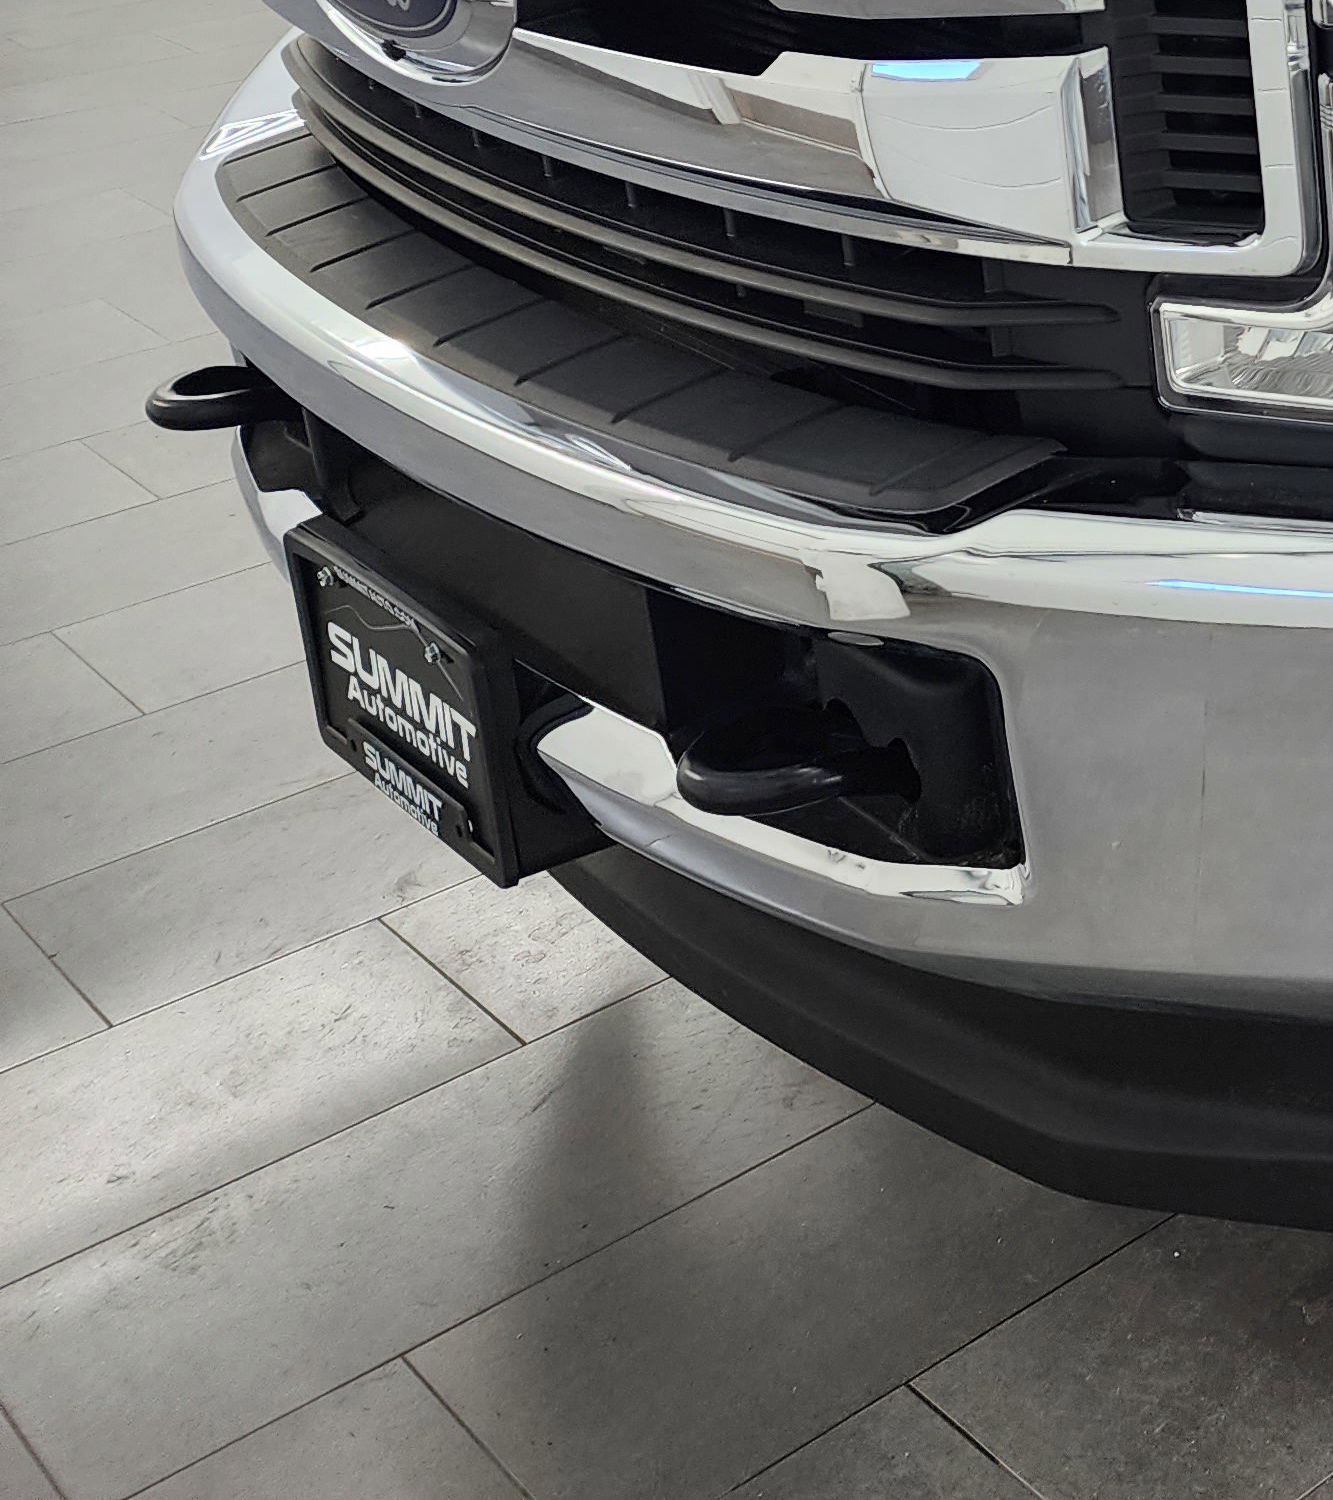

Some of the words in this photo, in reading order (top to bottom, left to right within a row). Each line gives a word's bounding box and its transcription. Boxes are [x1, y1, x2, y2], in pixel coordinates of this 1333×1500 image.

[327, 621, 477, 762] SUMMIT
[347, 676, 469, 789] Automotive
[362, 741, 443, 822] SUMMIT
[374, 772, 440, 837] Automotive
